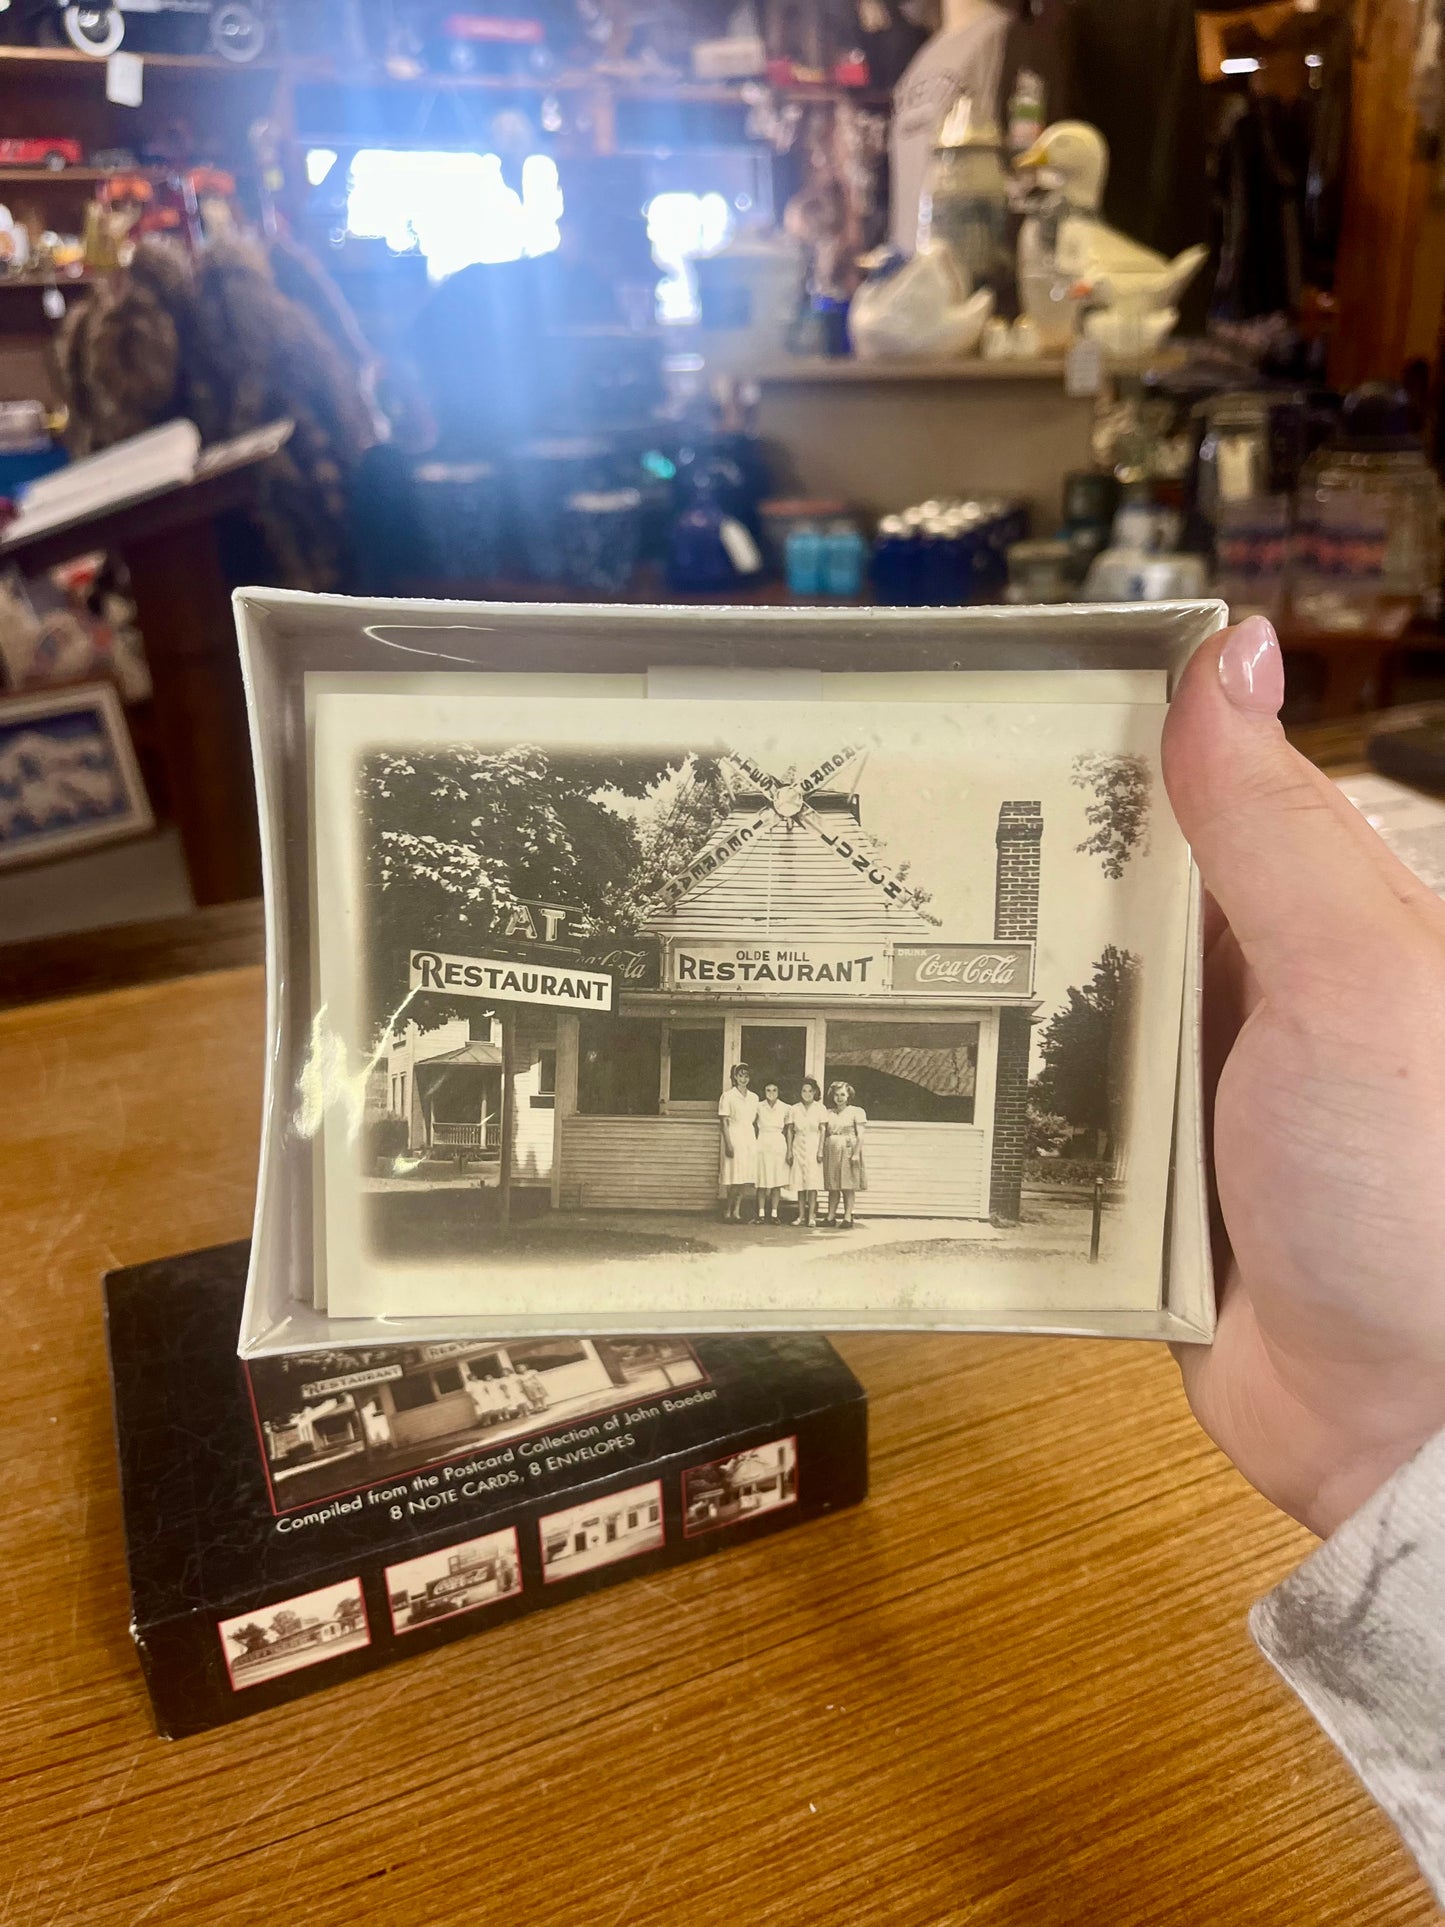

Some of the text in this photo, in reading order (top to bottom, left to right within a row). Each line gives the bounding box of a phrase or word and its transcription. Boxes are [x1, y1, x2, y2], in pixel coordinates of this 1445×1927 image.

[820, 832, 903, 901] LUNCH
[411, 952, 609, 1002] RESTAURANT
[679, 953, 874, 983] RESTAURANT
[735, 950, 810, 962] OLDE MILL
[275, 1389, 718, 1533] Compiled from the Postcard Collection of John Baeder
[389, 1433, 636, 1521] 8 NOTE CARDS, 8 ENVELOPES
